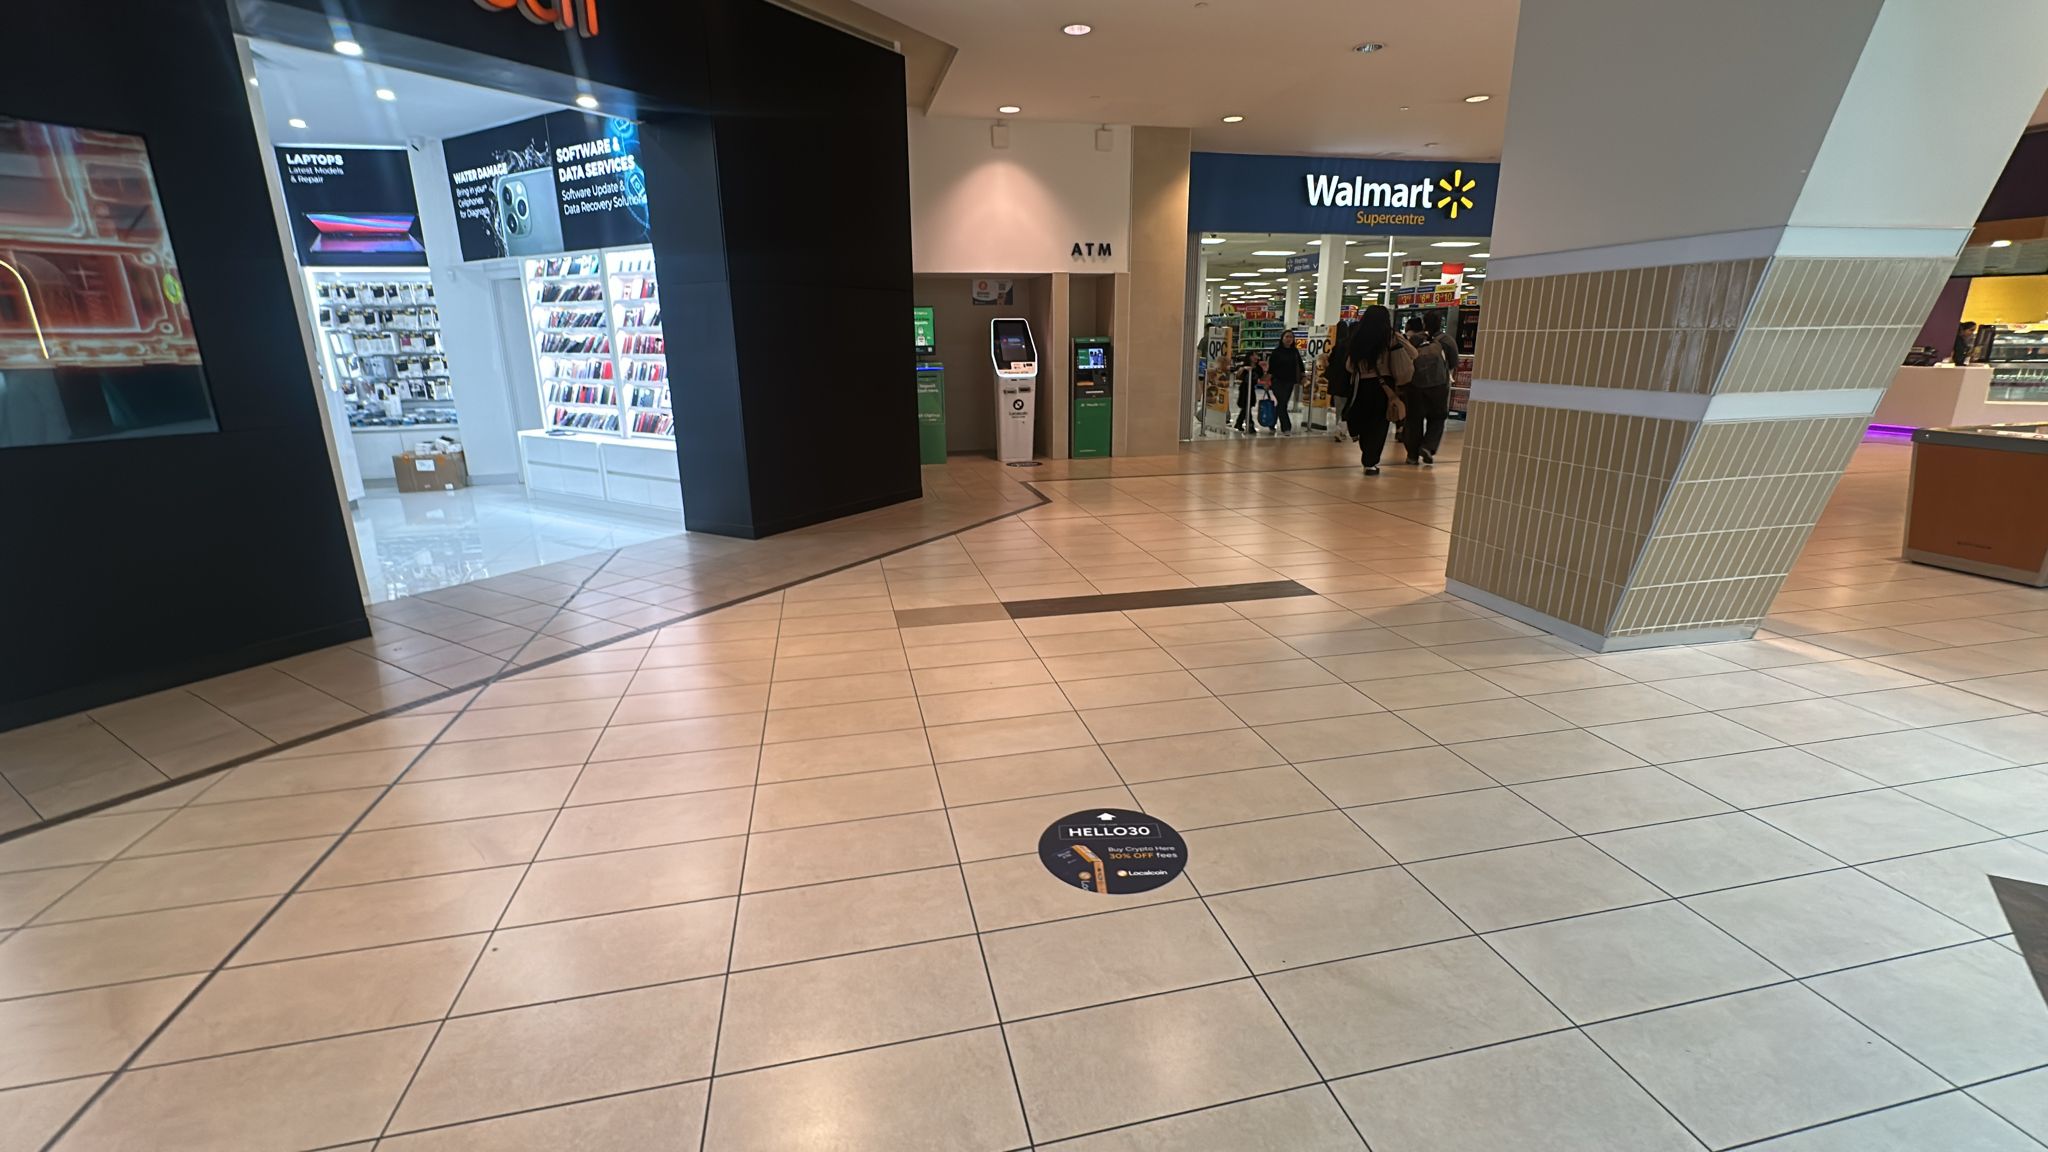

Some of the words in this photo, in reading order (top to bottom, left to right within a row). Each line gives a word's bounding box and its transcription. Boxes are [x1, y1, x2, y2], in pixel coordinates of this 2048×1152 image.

[556, 138, 611, 163] SOFTWARE
[612, 136, 621, 152] &
[285, 153, 344, 166] LAPTOPS
[558, 164, 585, 183] DATA
[585, 154, 635, 178] SERVICES
[288, 166, 314, 175] Latest
[314, 166, 345, 176] Models
[297, 174, 324, 185] Repair
[453, 169, 478, 185] WATER
[477, 162, 508, 180] DAMAGE
[561, 187, 591, 202] Software
[592, 182, 619, 198] Update
[619, 179, 626, 193] &
[1306, 173, 1434, 209] Walmart
[563, 203, 581, 216] Data
[581, 198, 613, 213] Recovery
[1356, 210, 1425, 227] Supercentre
[1071, 242, 1112, 257] ATM
[1209, 340, 1228, 360] QPC
[1308, 338, 1332, 358] QPC
[1068, 826, 1151, 837] HELLO30
[1109, 852, 1132, 860] 30%
